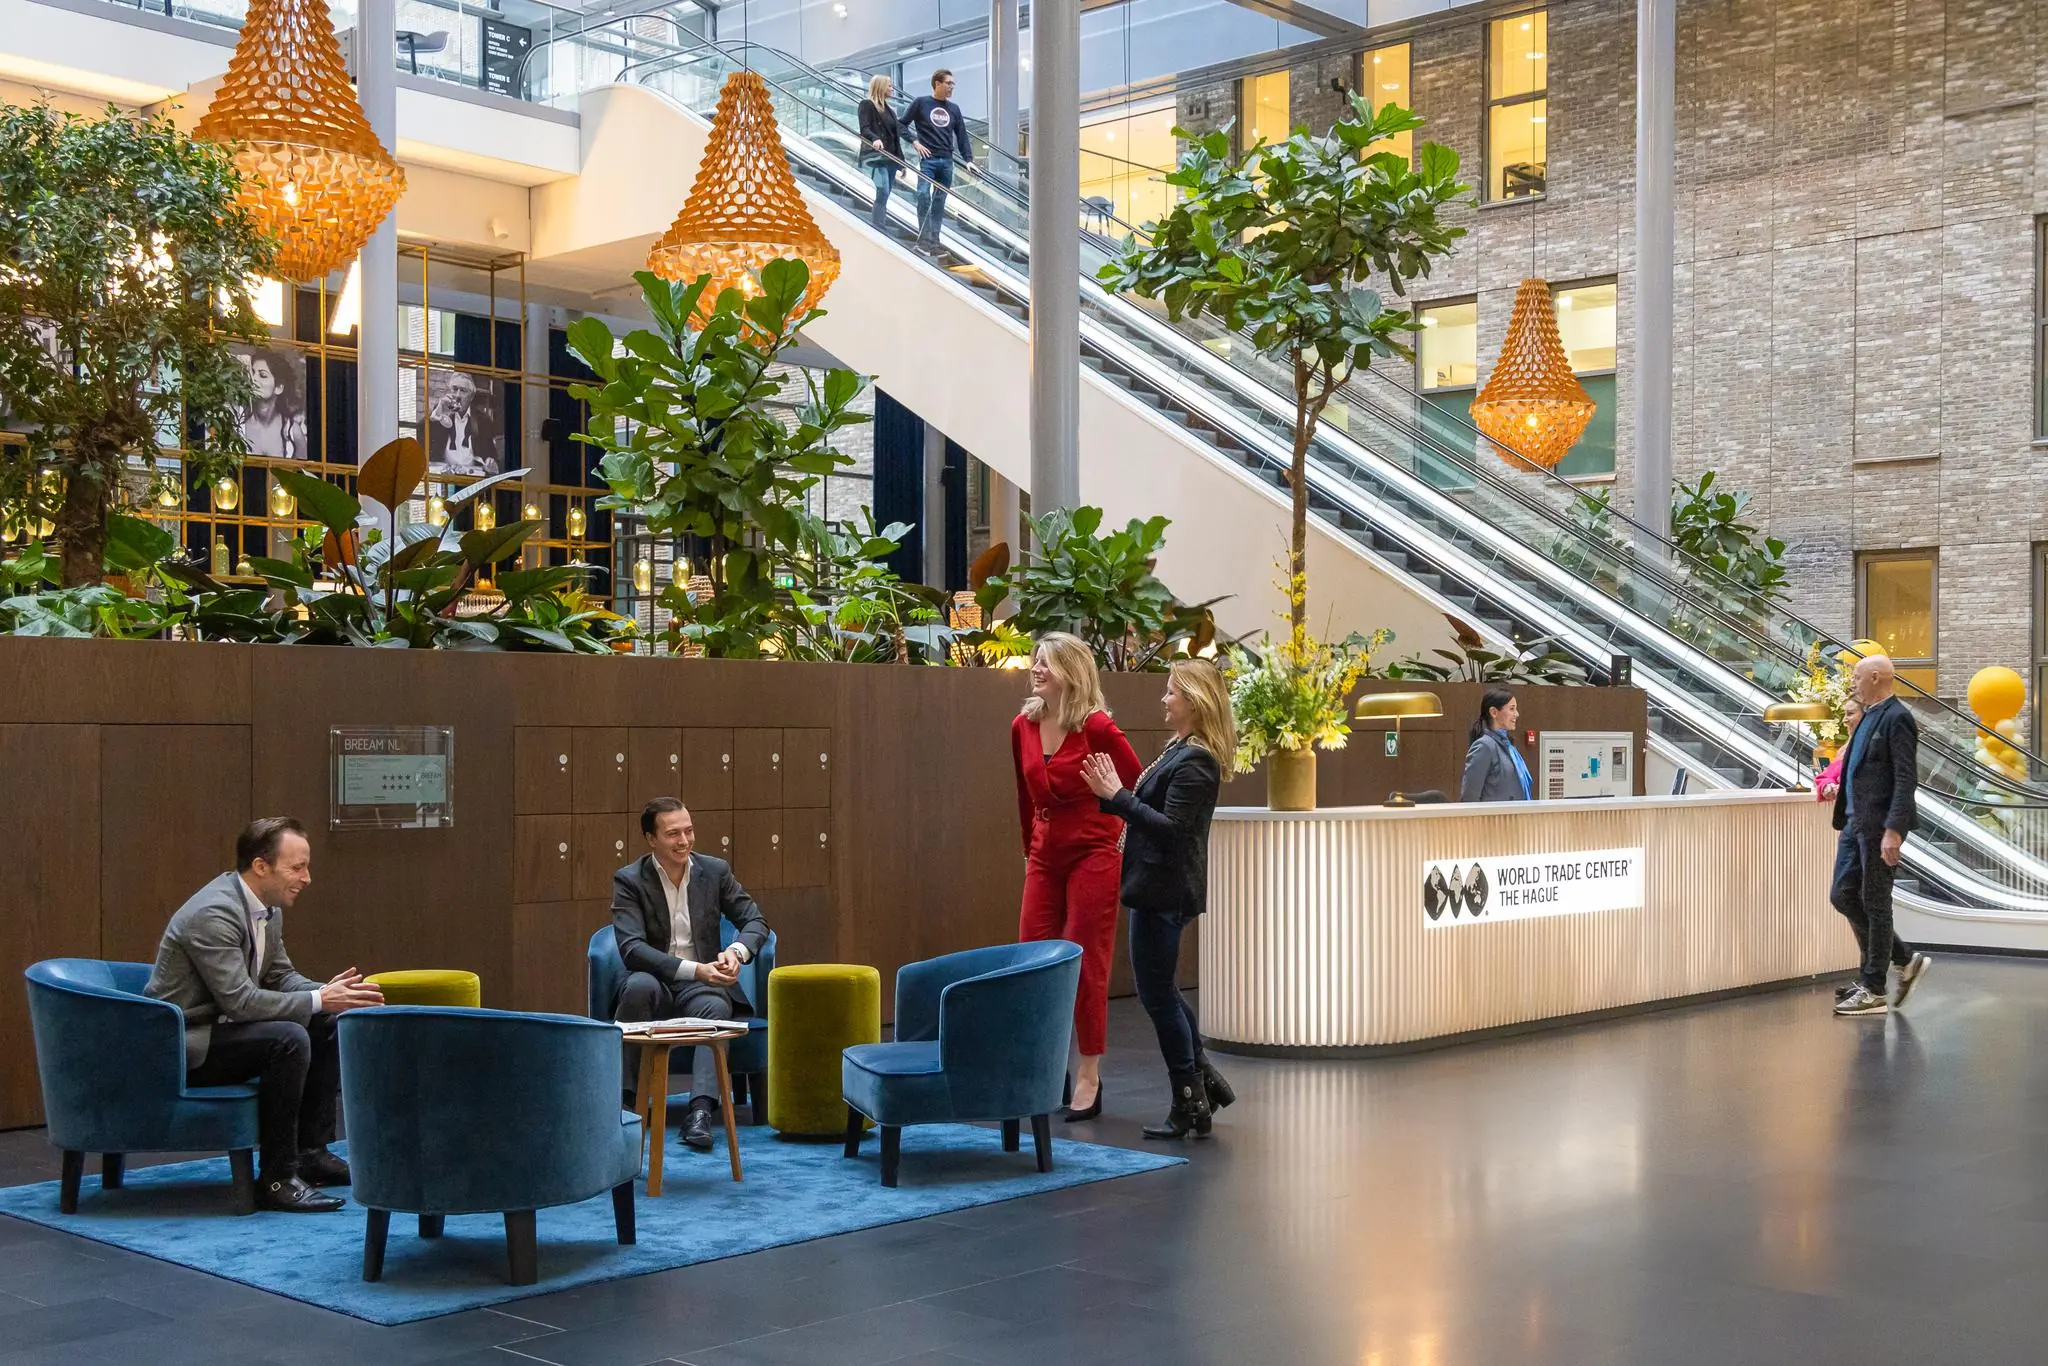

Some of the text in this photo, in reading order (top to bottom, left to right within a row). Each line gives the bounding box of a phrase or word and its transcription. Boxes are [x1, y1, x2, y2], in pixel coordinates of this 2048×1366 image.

[487, 31, 505, 41] TOWER
[488, 72, 505, 82] TOWER
[344, 739, 400, 751] BREEAM NL
[1497, 867, 1540, 886] WORLD
[1545, 863, 1581, 882] TRADE
[1499, 886, 1558, 906] THE HAGUE
